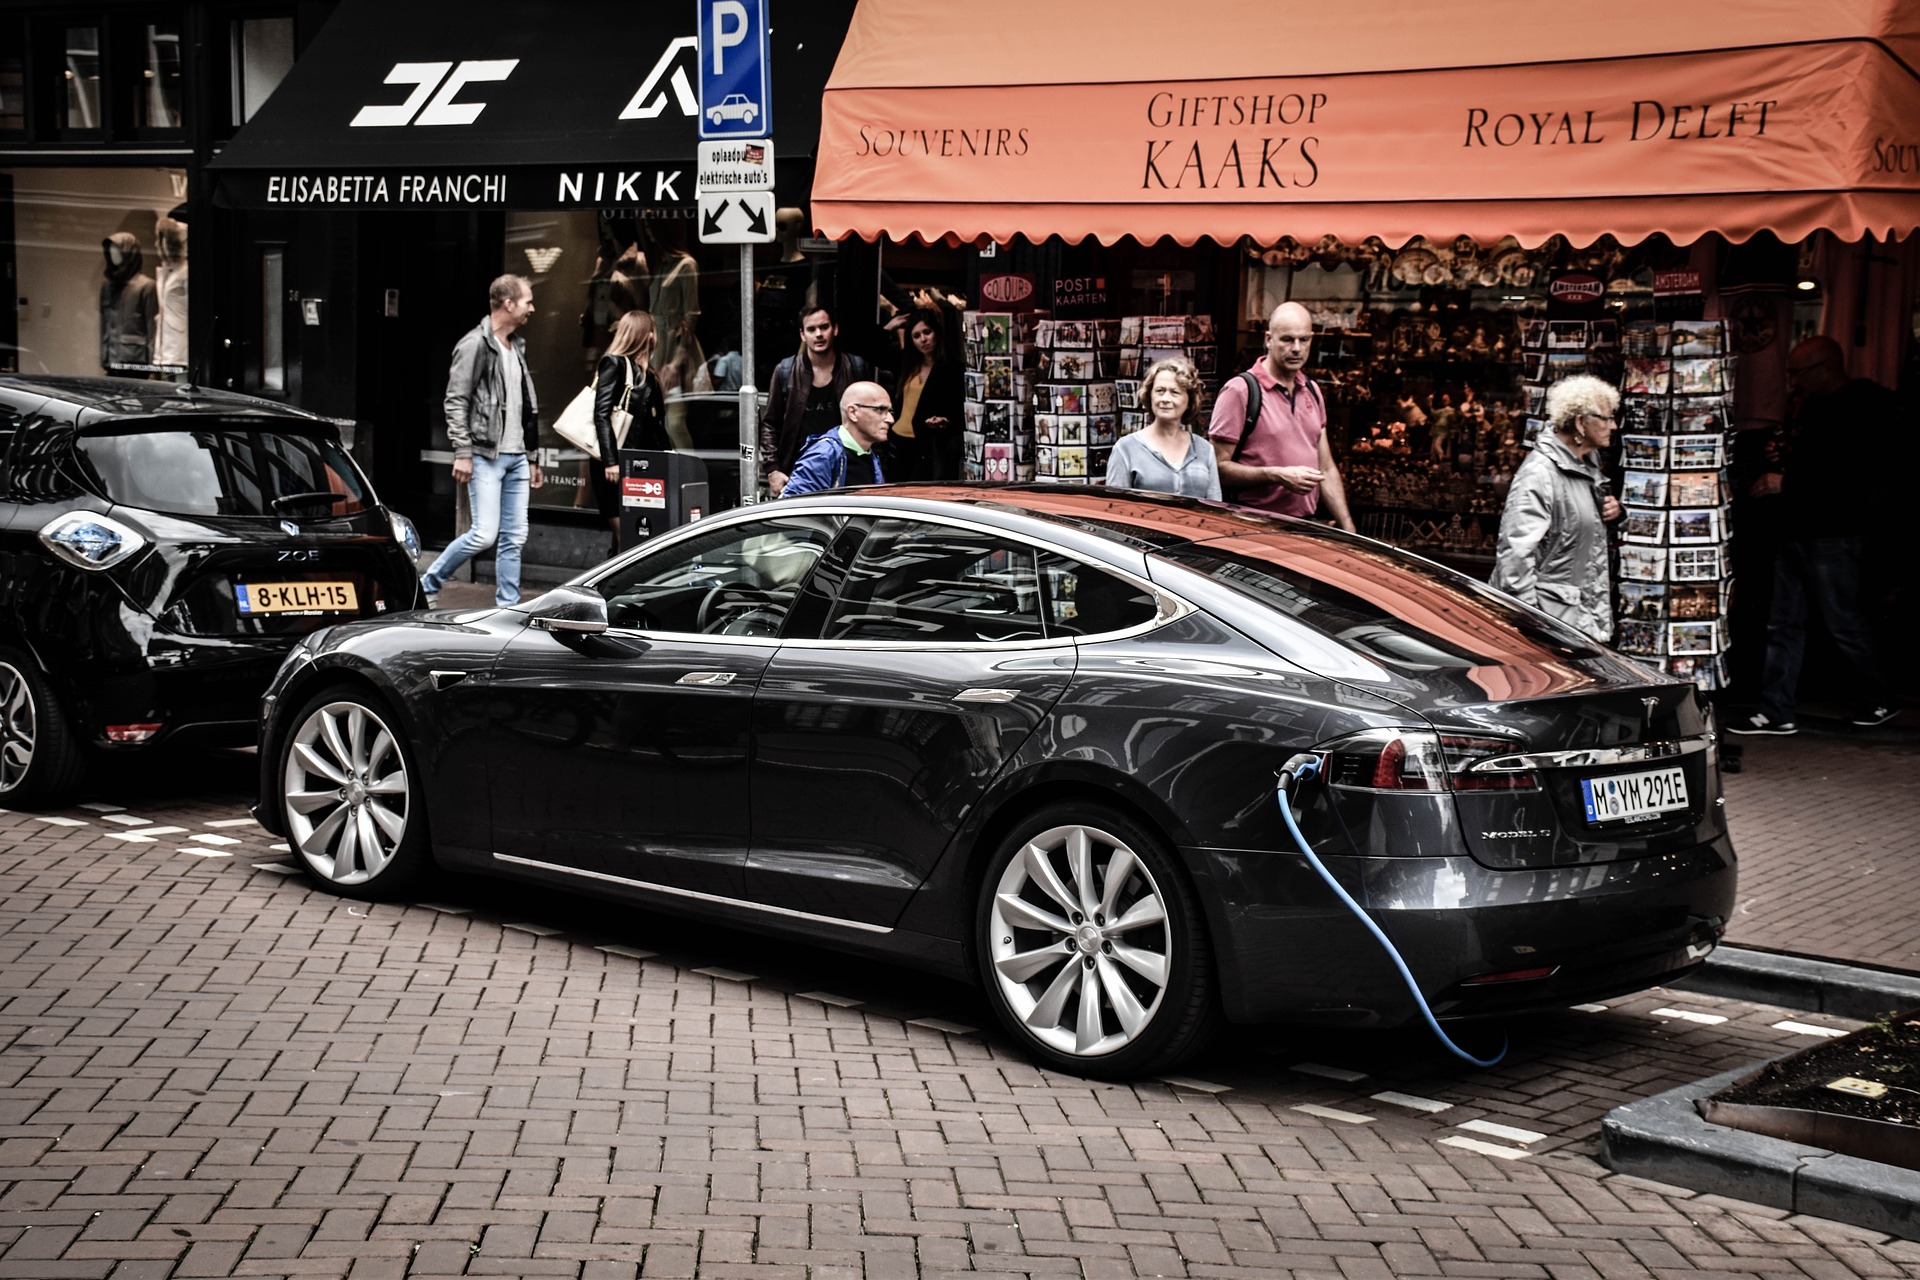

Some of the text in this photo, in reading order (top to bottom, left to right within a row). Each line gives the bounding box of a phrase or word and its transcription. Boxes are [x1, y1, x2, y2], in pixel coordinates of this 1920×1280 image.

[713, 1, 748, 75] P
[1148, 92, 1327, 128] GIFTSHOP
[1464, 99, 1778, 148] ROYAL DELFT
[856, 125, 1029, 157] SOUVENIRS
[1142, 137, 1319, 189] KAAKS
[699, 169, 768, 185] elektrische auto's
[266, 174, 507, 203] ELISABETTA FRANCHI
[986, 278, 1030, 300] COLOURS
[1055, 277, 1091, 293] POST
[1553, 281, 1600, 294] AMSTERDAM
[1655, 272, 1701, 289] AMSTERDAM
[1056, 292, 1107, 306] KAARTEN
[551, 475, 586, 487] FRANCHI
[277, 550, 319, 562] ZOE
[258, 586, 347, 607] 8-KLH-15
[1643, 772, 1687, 808] 291E
[1481, 829, 1551, 840] MODEL S
